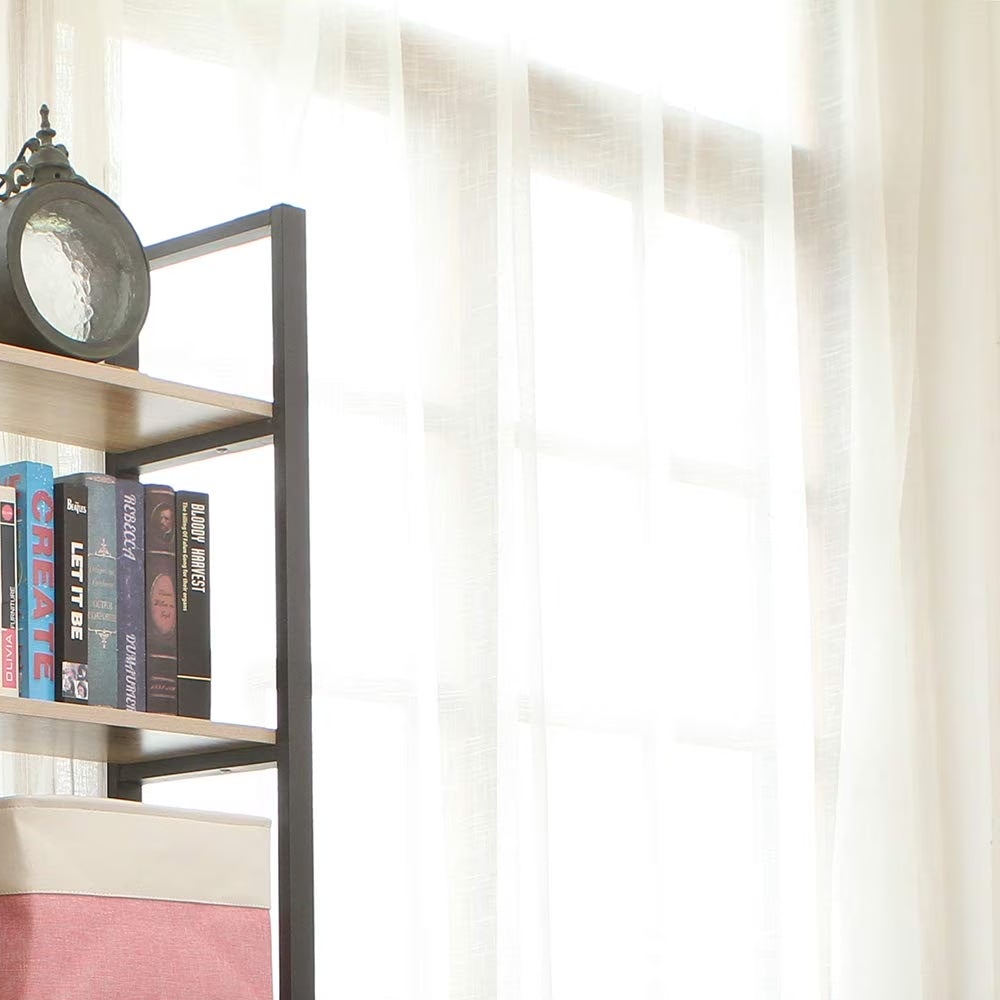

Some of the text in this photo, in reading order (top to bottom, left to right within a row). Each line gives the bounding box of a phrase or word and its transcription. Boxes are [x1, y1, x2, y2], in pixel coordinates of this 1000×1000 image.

[123, 494, 137, 561] REBECCA
[191, 503, 206, 593] BLOODY HARVEST
[32, 489, 55, 682] CREATE
[71, 541, 84, 641] LET IT BE
[5, 634, 13, 682] OLIVIA
